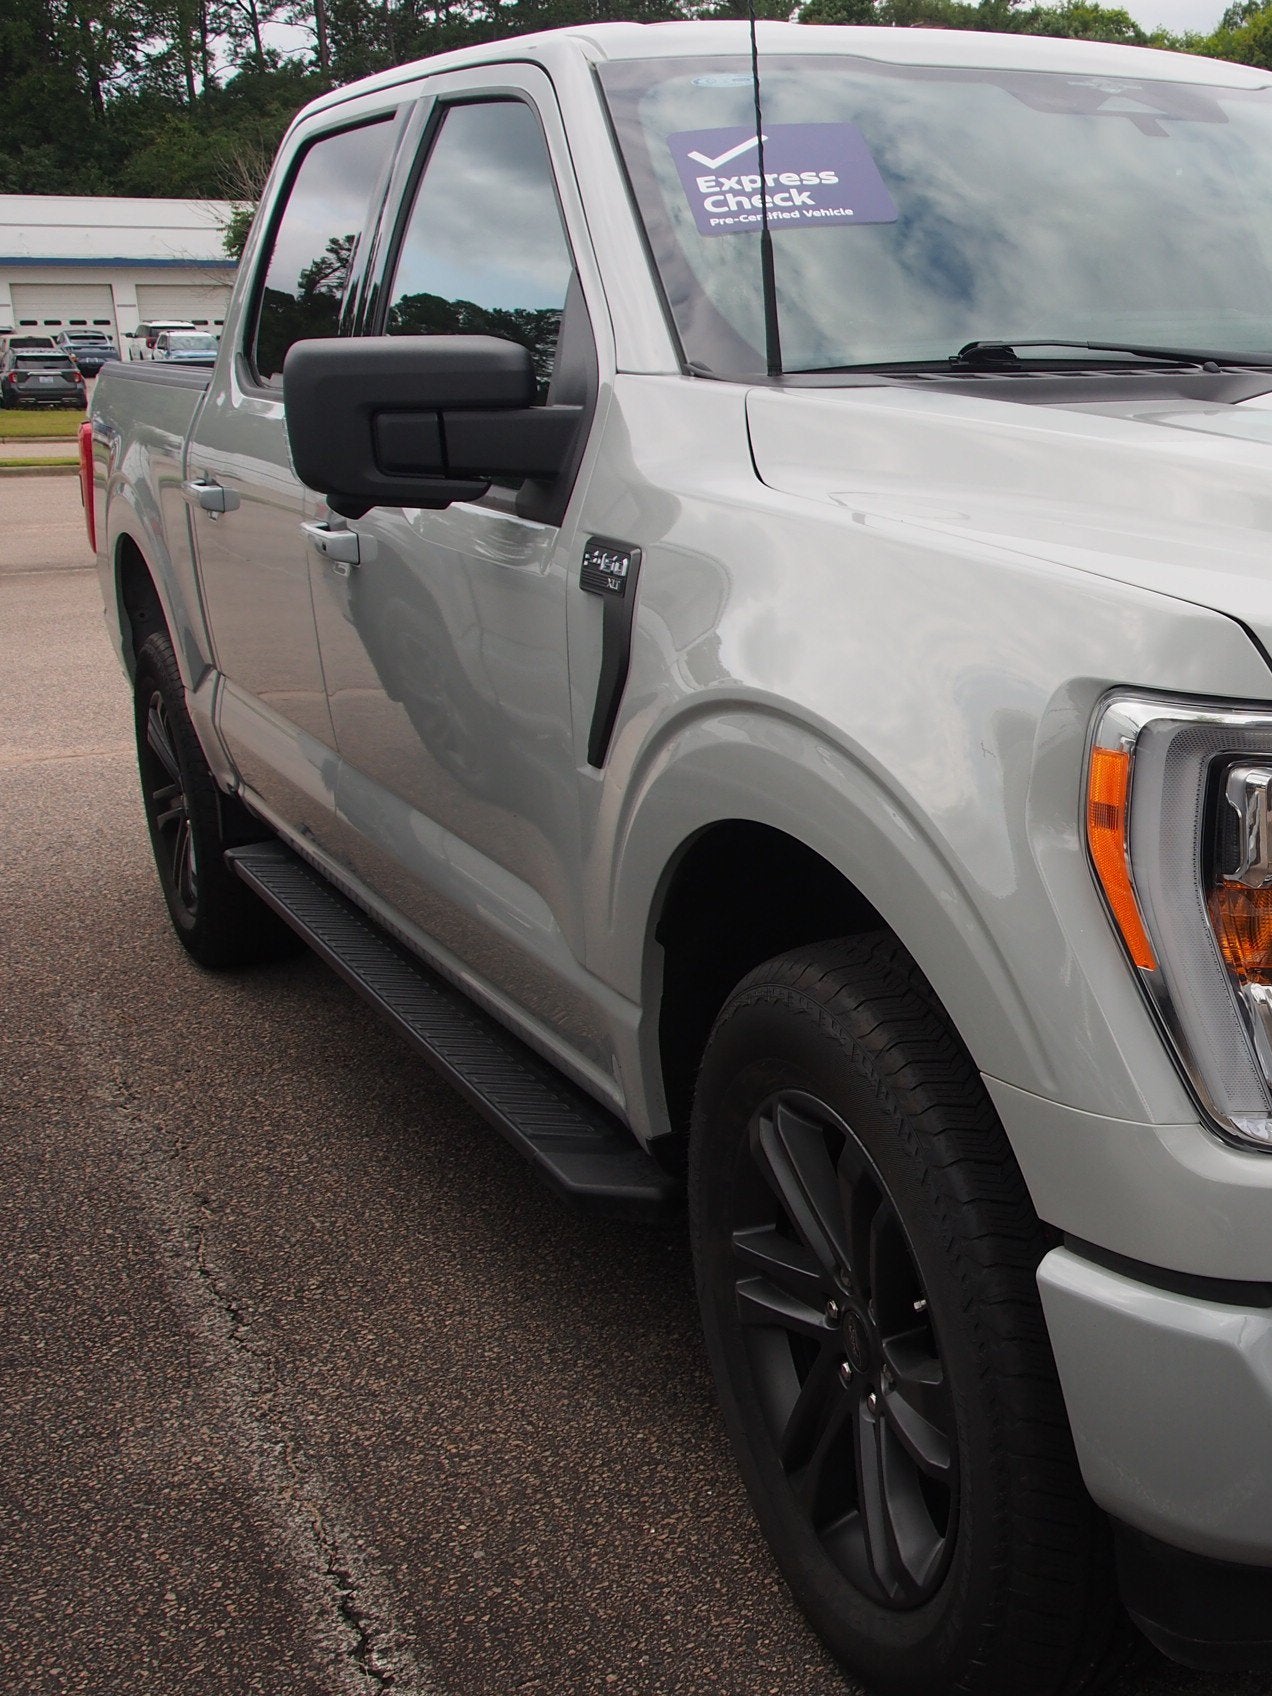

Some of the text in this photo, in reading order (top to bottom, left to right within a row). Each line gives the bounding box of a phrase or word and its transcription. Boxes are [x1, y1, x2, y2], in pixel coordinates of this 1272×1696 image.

[696, 171, 839, 193] Express
[703, 188, 816, 213] Check
[709, 207, 854, 227] Pre-Cerified Vehicle
